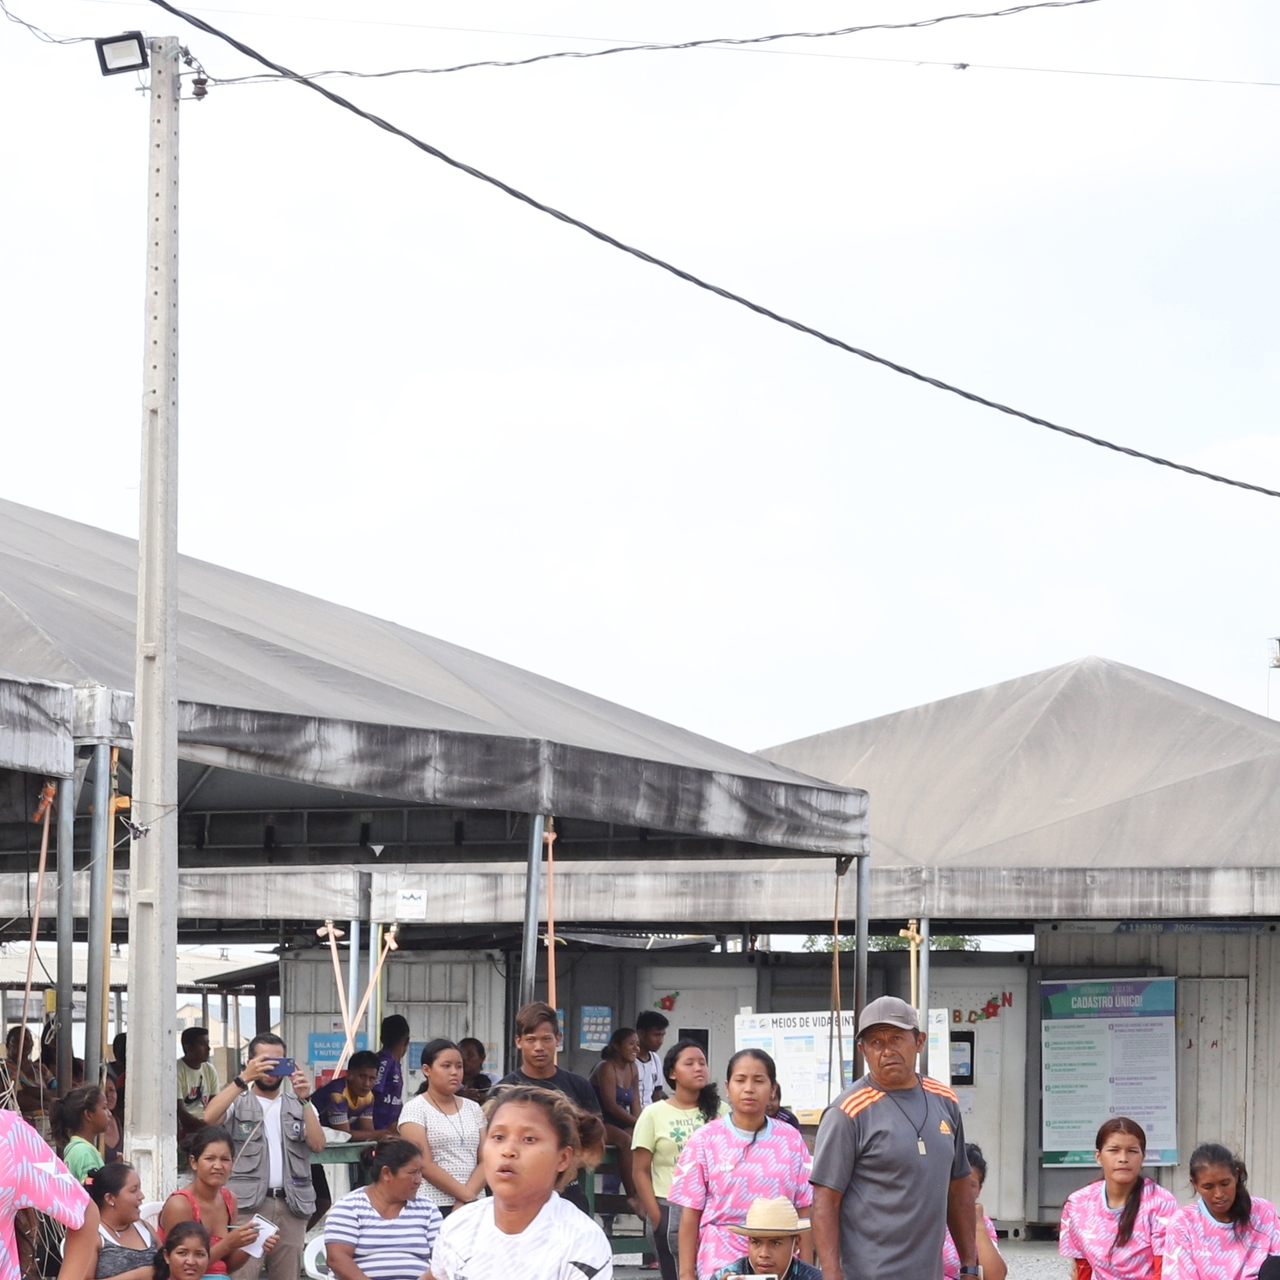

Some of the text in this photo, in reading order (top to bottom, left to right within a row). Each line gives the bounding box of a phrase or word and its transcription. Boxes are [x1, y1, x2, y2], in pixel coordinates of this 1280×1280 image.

[1173, 924, 1196, 932] 2066
[1001, 991, 1013, 1007] N
[1071, 993, 1143, 1009] CADASTRO ÚNICO!
[771, 1017, 797, 1028] MEIOS
[800, 1017, 810, 1028] DE
[812, 1016, 831, 1027] VIDA
[952, 1009, 978, 1024] B C
[313, 1041, 331, 1049] SALA
